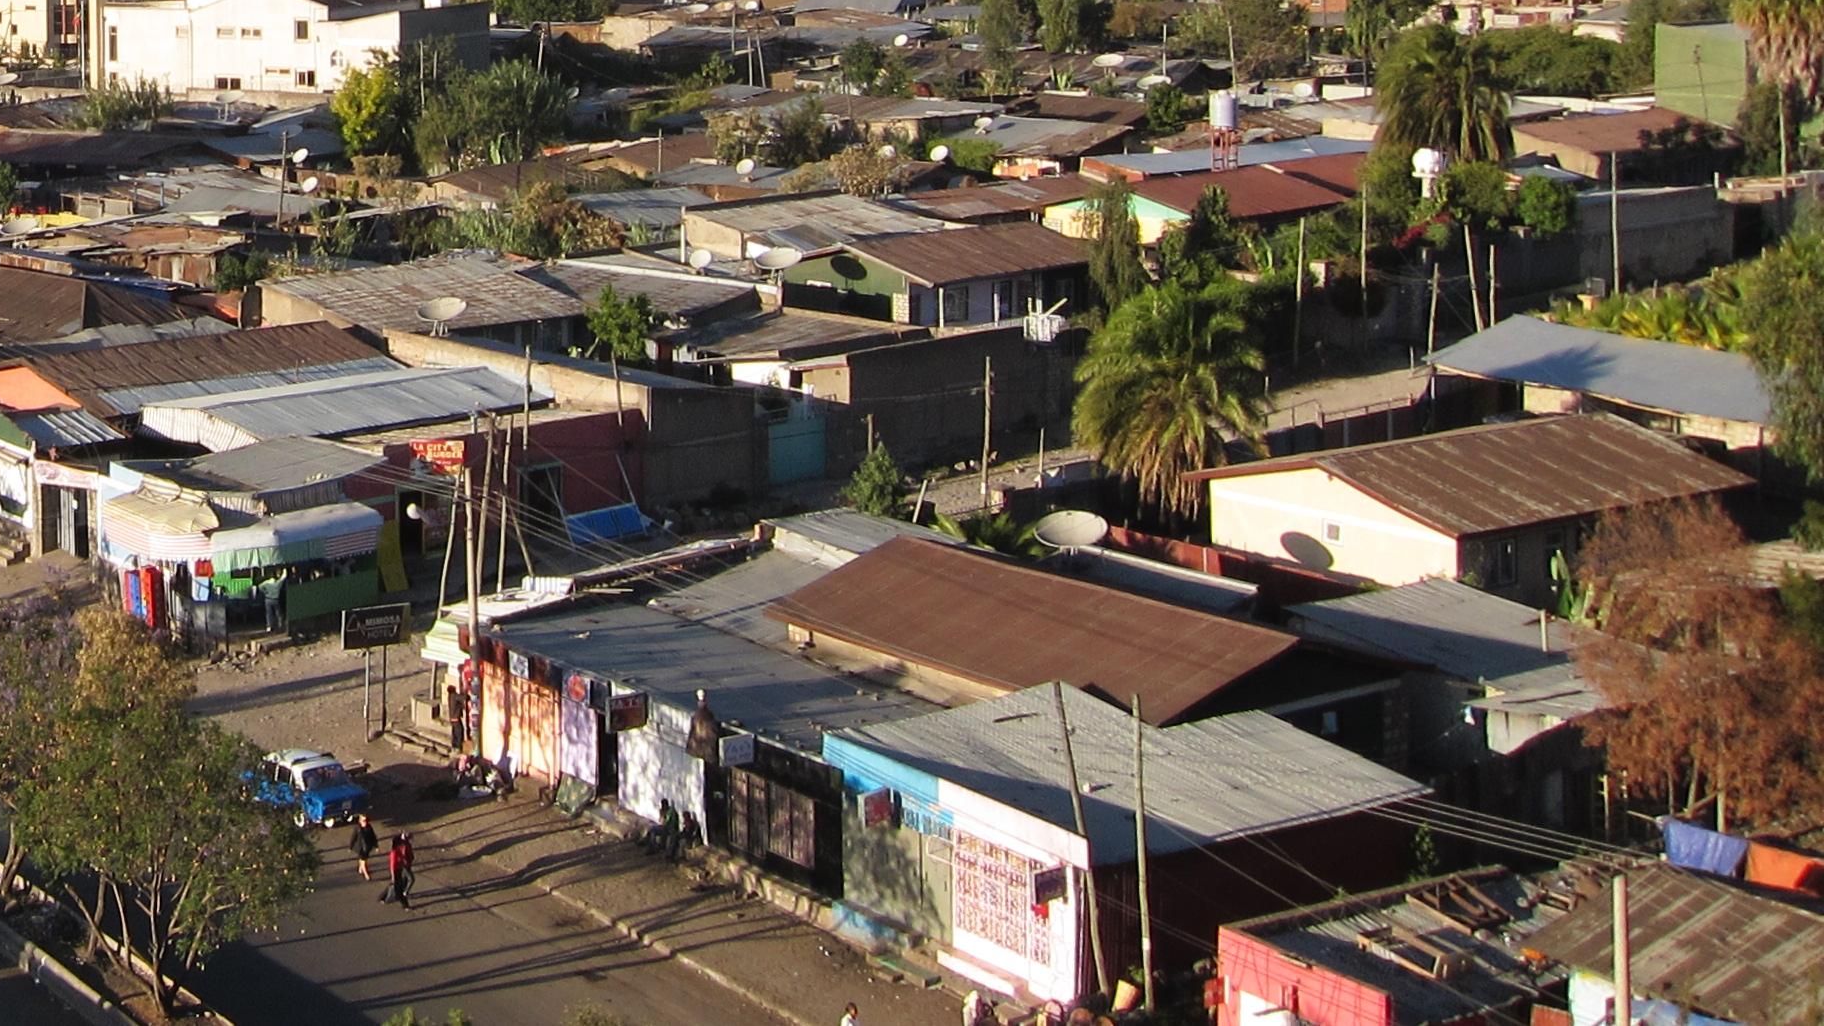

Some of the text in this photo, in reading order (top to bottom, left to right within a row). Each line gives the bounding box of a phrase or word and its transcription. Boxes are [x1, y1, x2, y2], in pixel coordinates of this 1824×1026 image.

[413, 443, 448, 451] LA CITY
[365, 615, 401, 626] MIMOSA
[367, 629, 395, 639] HOTEL
